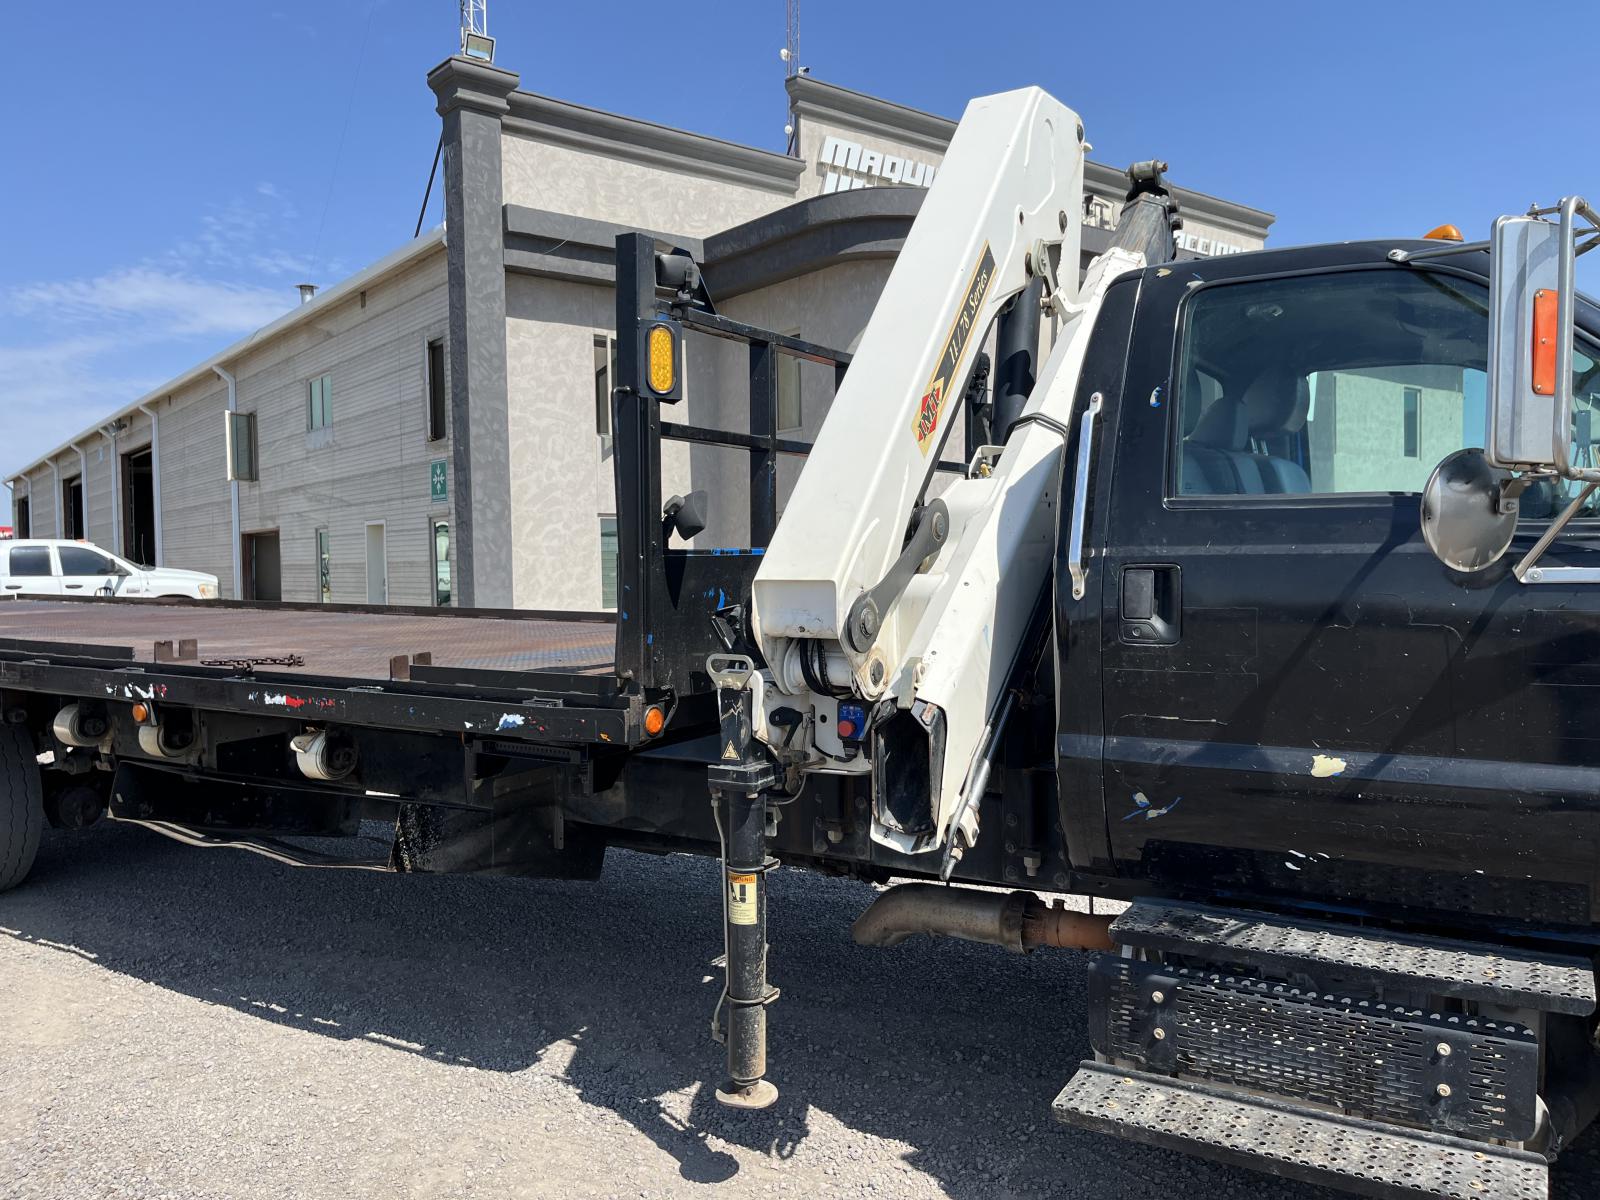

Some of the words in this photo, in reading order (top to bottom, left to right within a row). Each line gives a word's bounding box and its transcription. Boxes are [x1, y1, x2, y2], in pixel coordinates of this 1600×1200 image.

[820, 135, 939, 188] MAQUI
[949, 311, 970, 366] 11/78
[968, 269, 988, 316] Series
[918, 387, 940, 440] IMT
